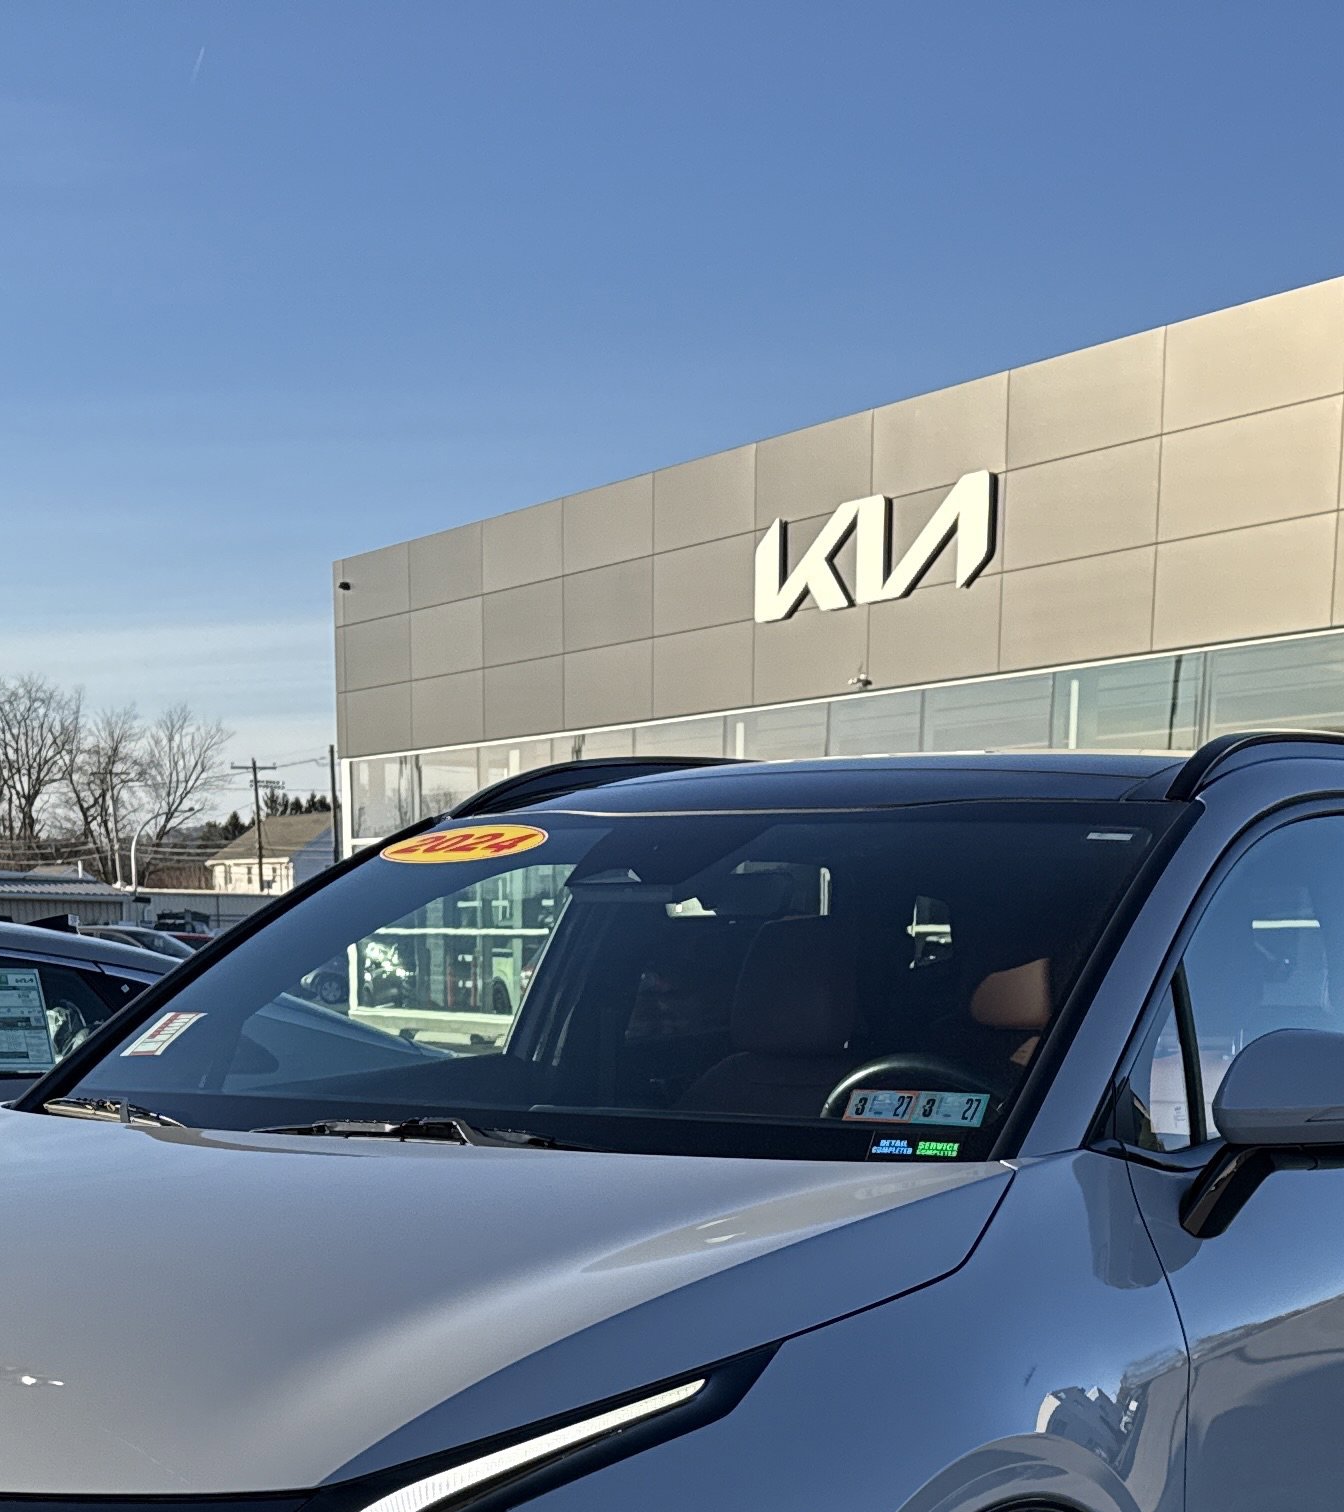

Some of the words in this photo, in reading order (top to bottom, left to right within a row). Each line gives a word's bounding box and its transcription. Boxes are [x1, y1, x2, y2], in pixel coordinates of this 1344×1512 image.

[754, 469, 999, 624] KIA
[390, 832, 539, 855] 2024
[855, 1097, 868, 1116] 3
[893, 1095, 913, 1118] 27
[922, 1098, 936, 1117] 3
[961, 1098, 981, 1122] 27
[872, 1146, 913, 1155] COMPLETED
[879, 1139, 908, 1147] DETAIL
[918, 1141, 960, 1151] SERVICE
